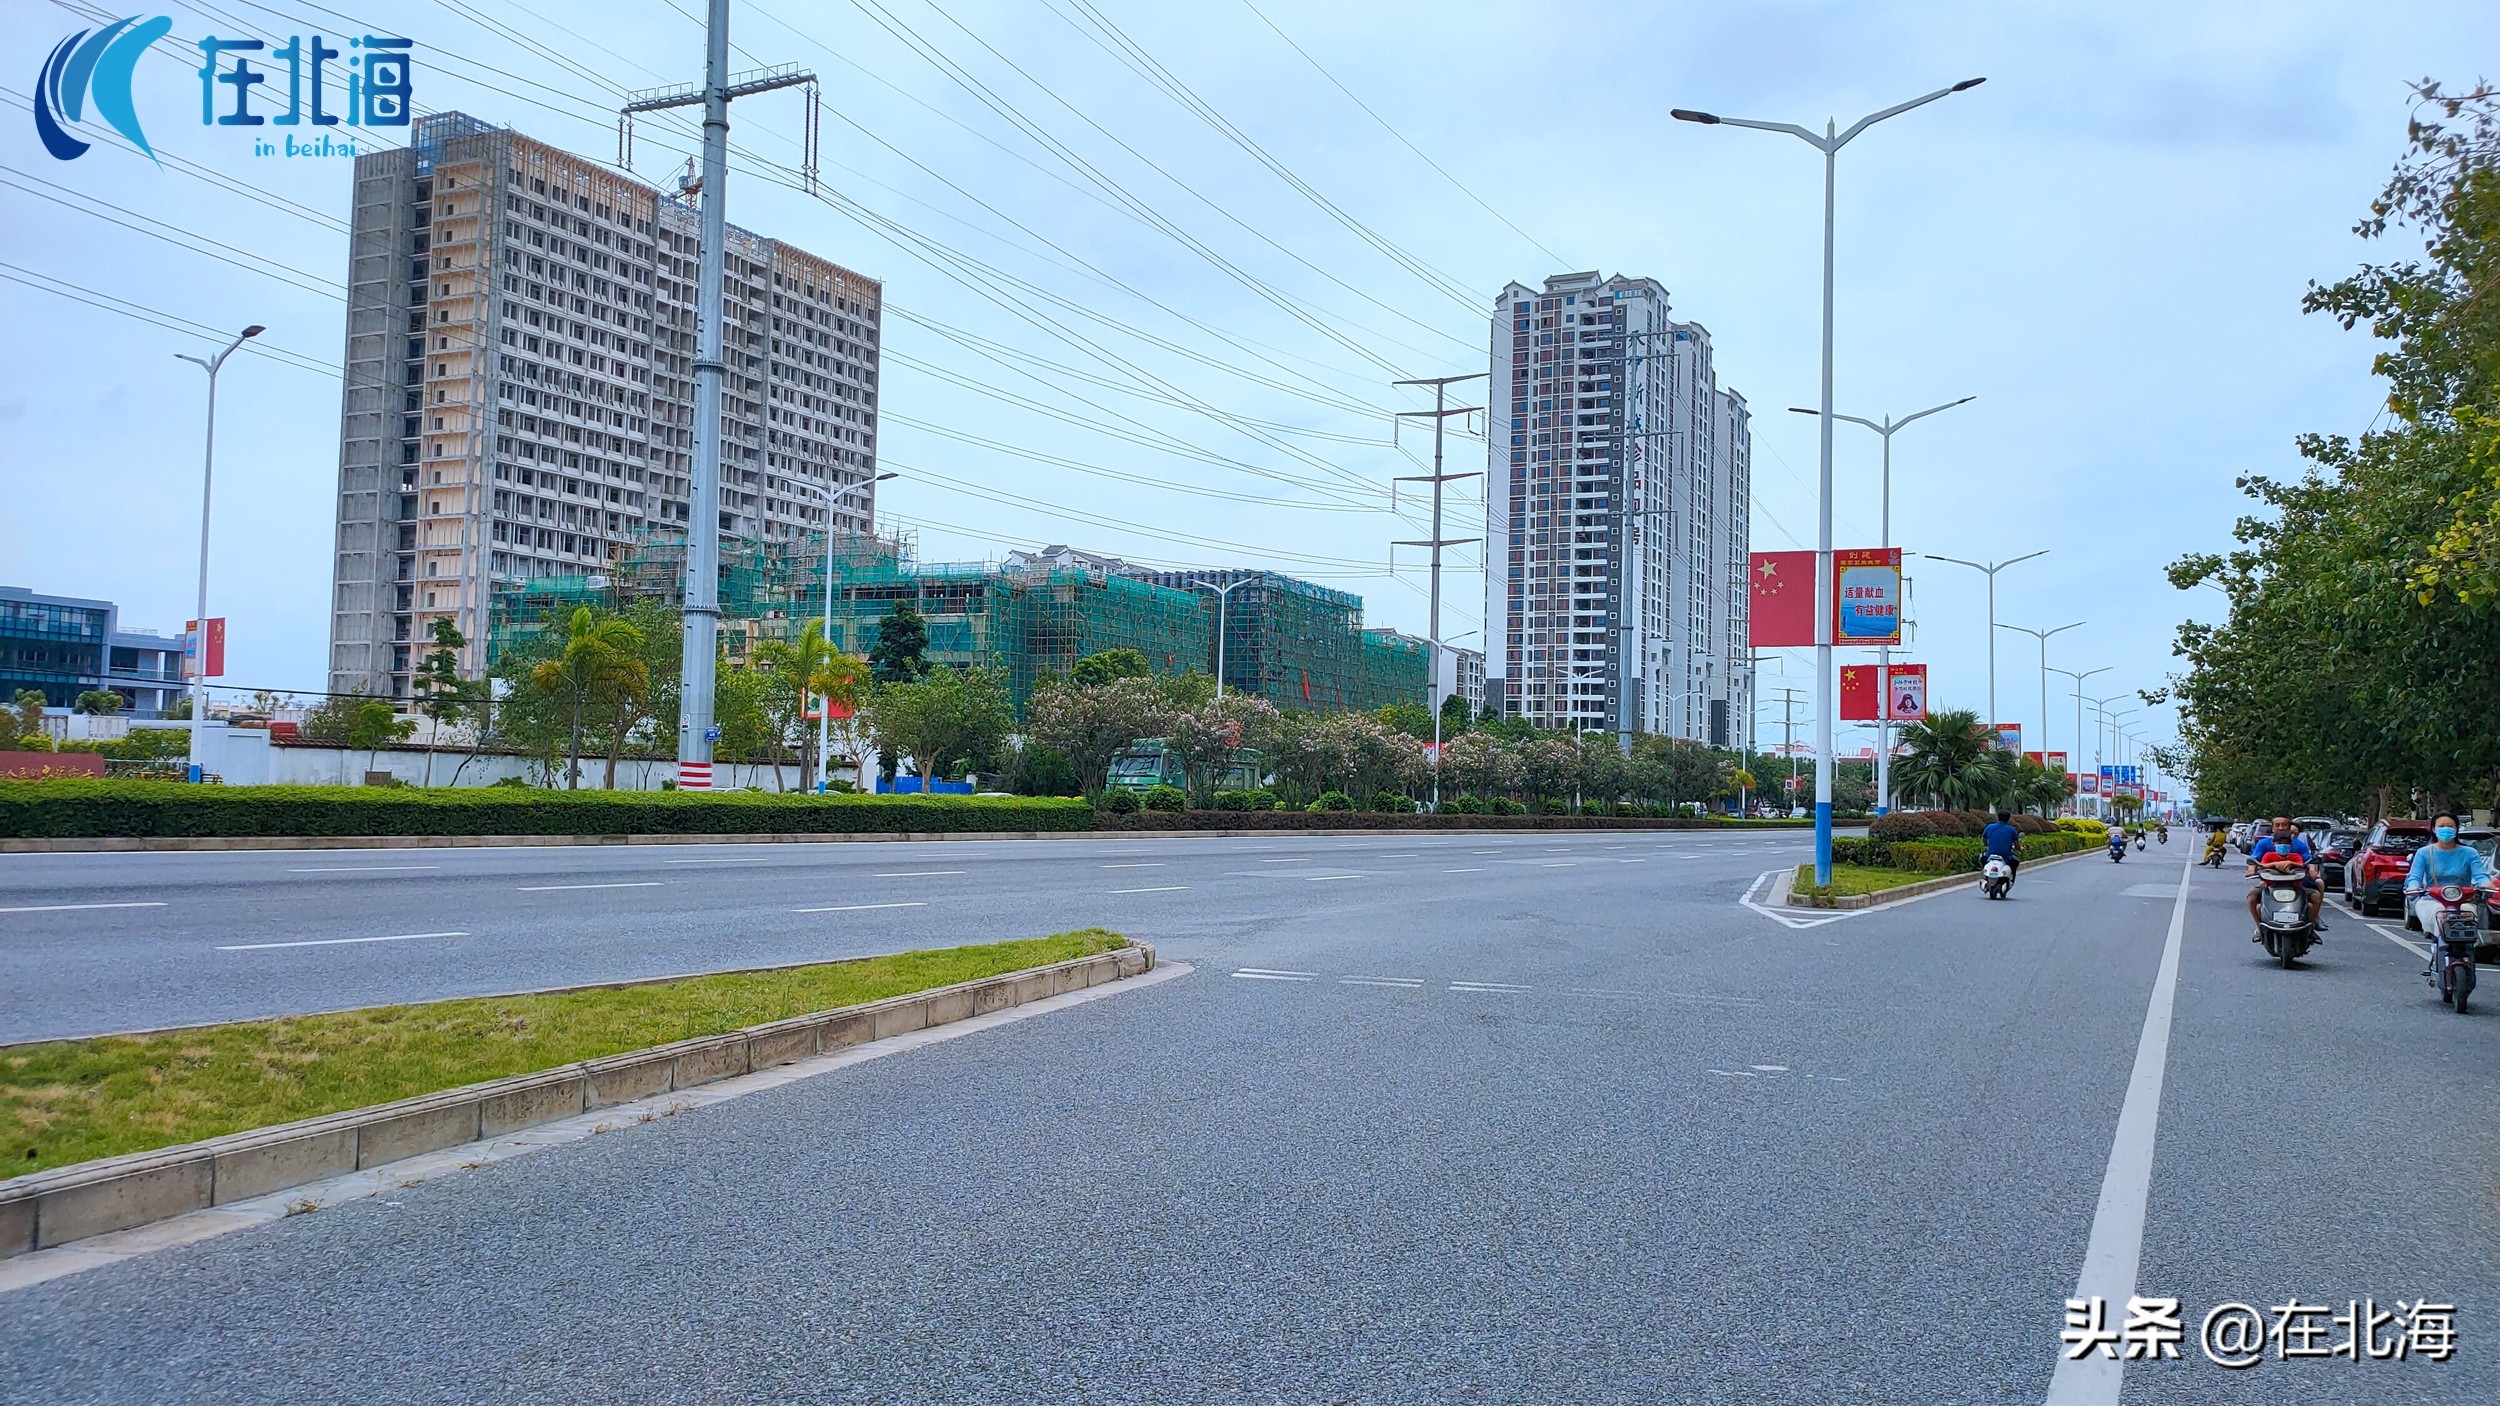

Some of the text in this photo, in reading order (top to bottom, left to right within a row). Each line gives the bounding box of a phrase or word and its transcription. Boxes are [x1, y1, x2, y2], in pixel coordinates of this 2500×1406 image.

[1844, 586, 1884, 599] 适量献血
[1855, 604, 1895, 617] 有益健康
